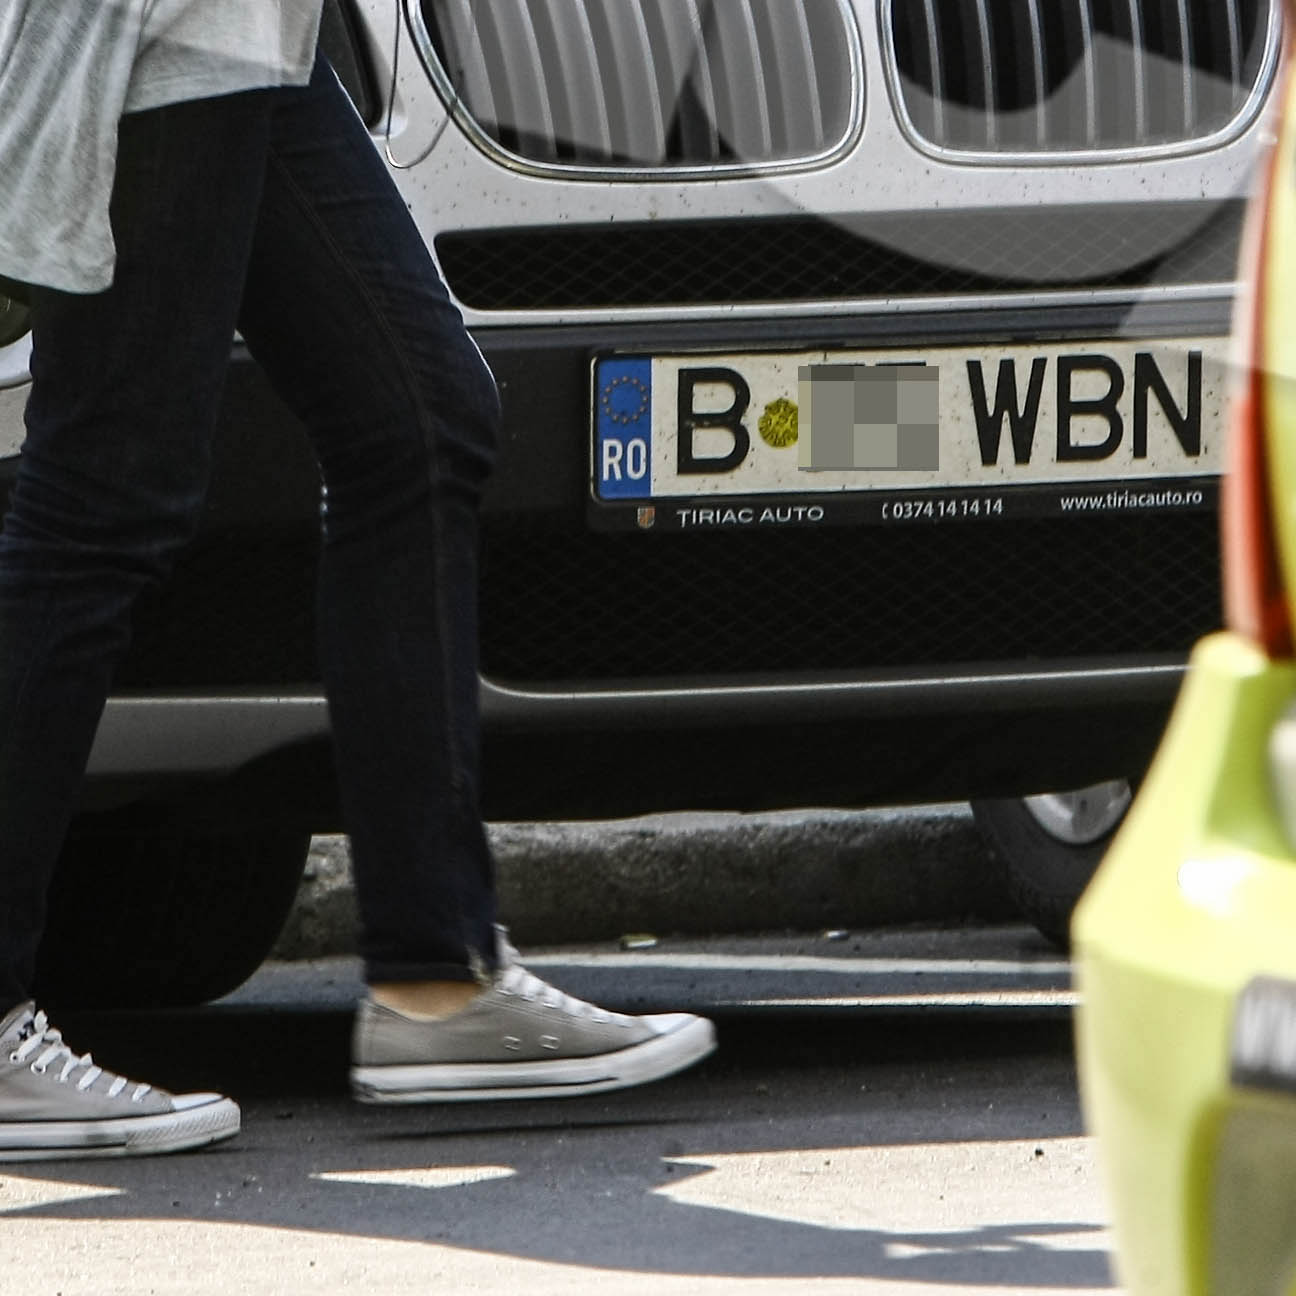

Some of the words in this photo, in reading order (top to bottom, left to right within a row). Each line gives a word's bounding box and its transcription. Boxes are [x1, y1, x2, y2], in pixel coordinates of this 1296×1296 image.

[603, 437, 647, 482] RO
[676, 366, 751, 475] B
[966, 351, 1202, 466] WBN
[676, 508, 753, 528] TIRIAC
[759, 506, 824, 523] AUTO
[1060, 490, 1203, 511] www.tiriacauto.ro
